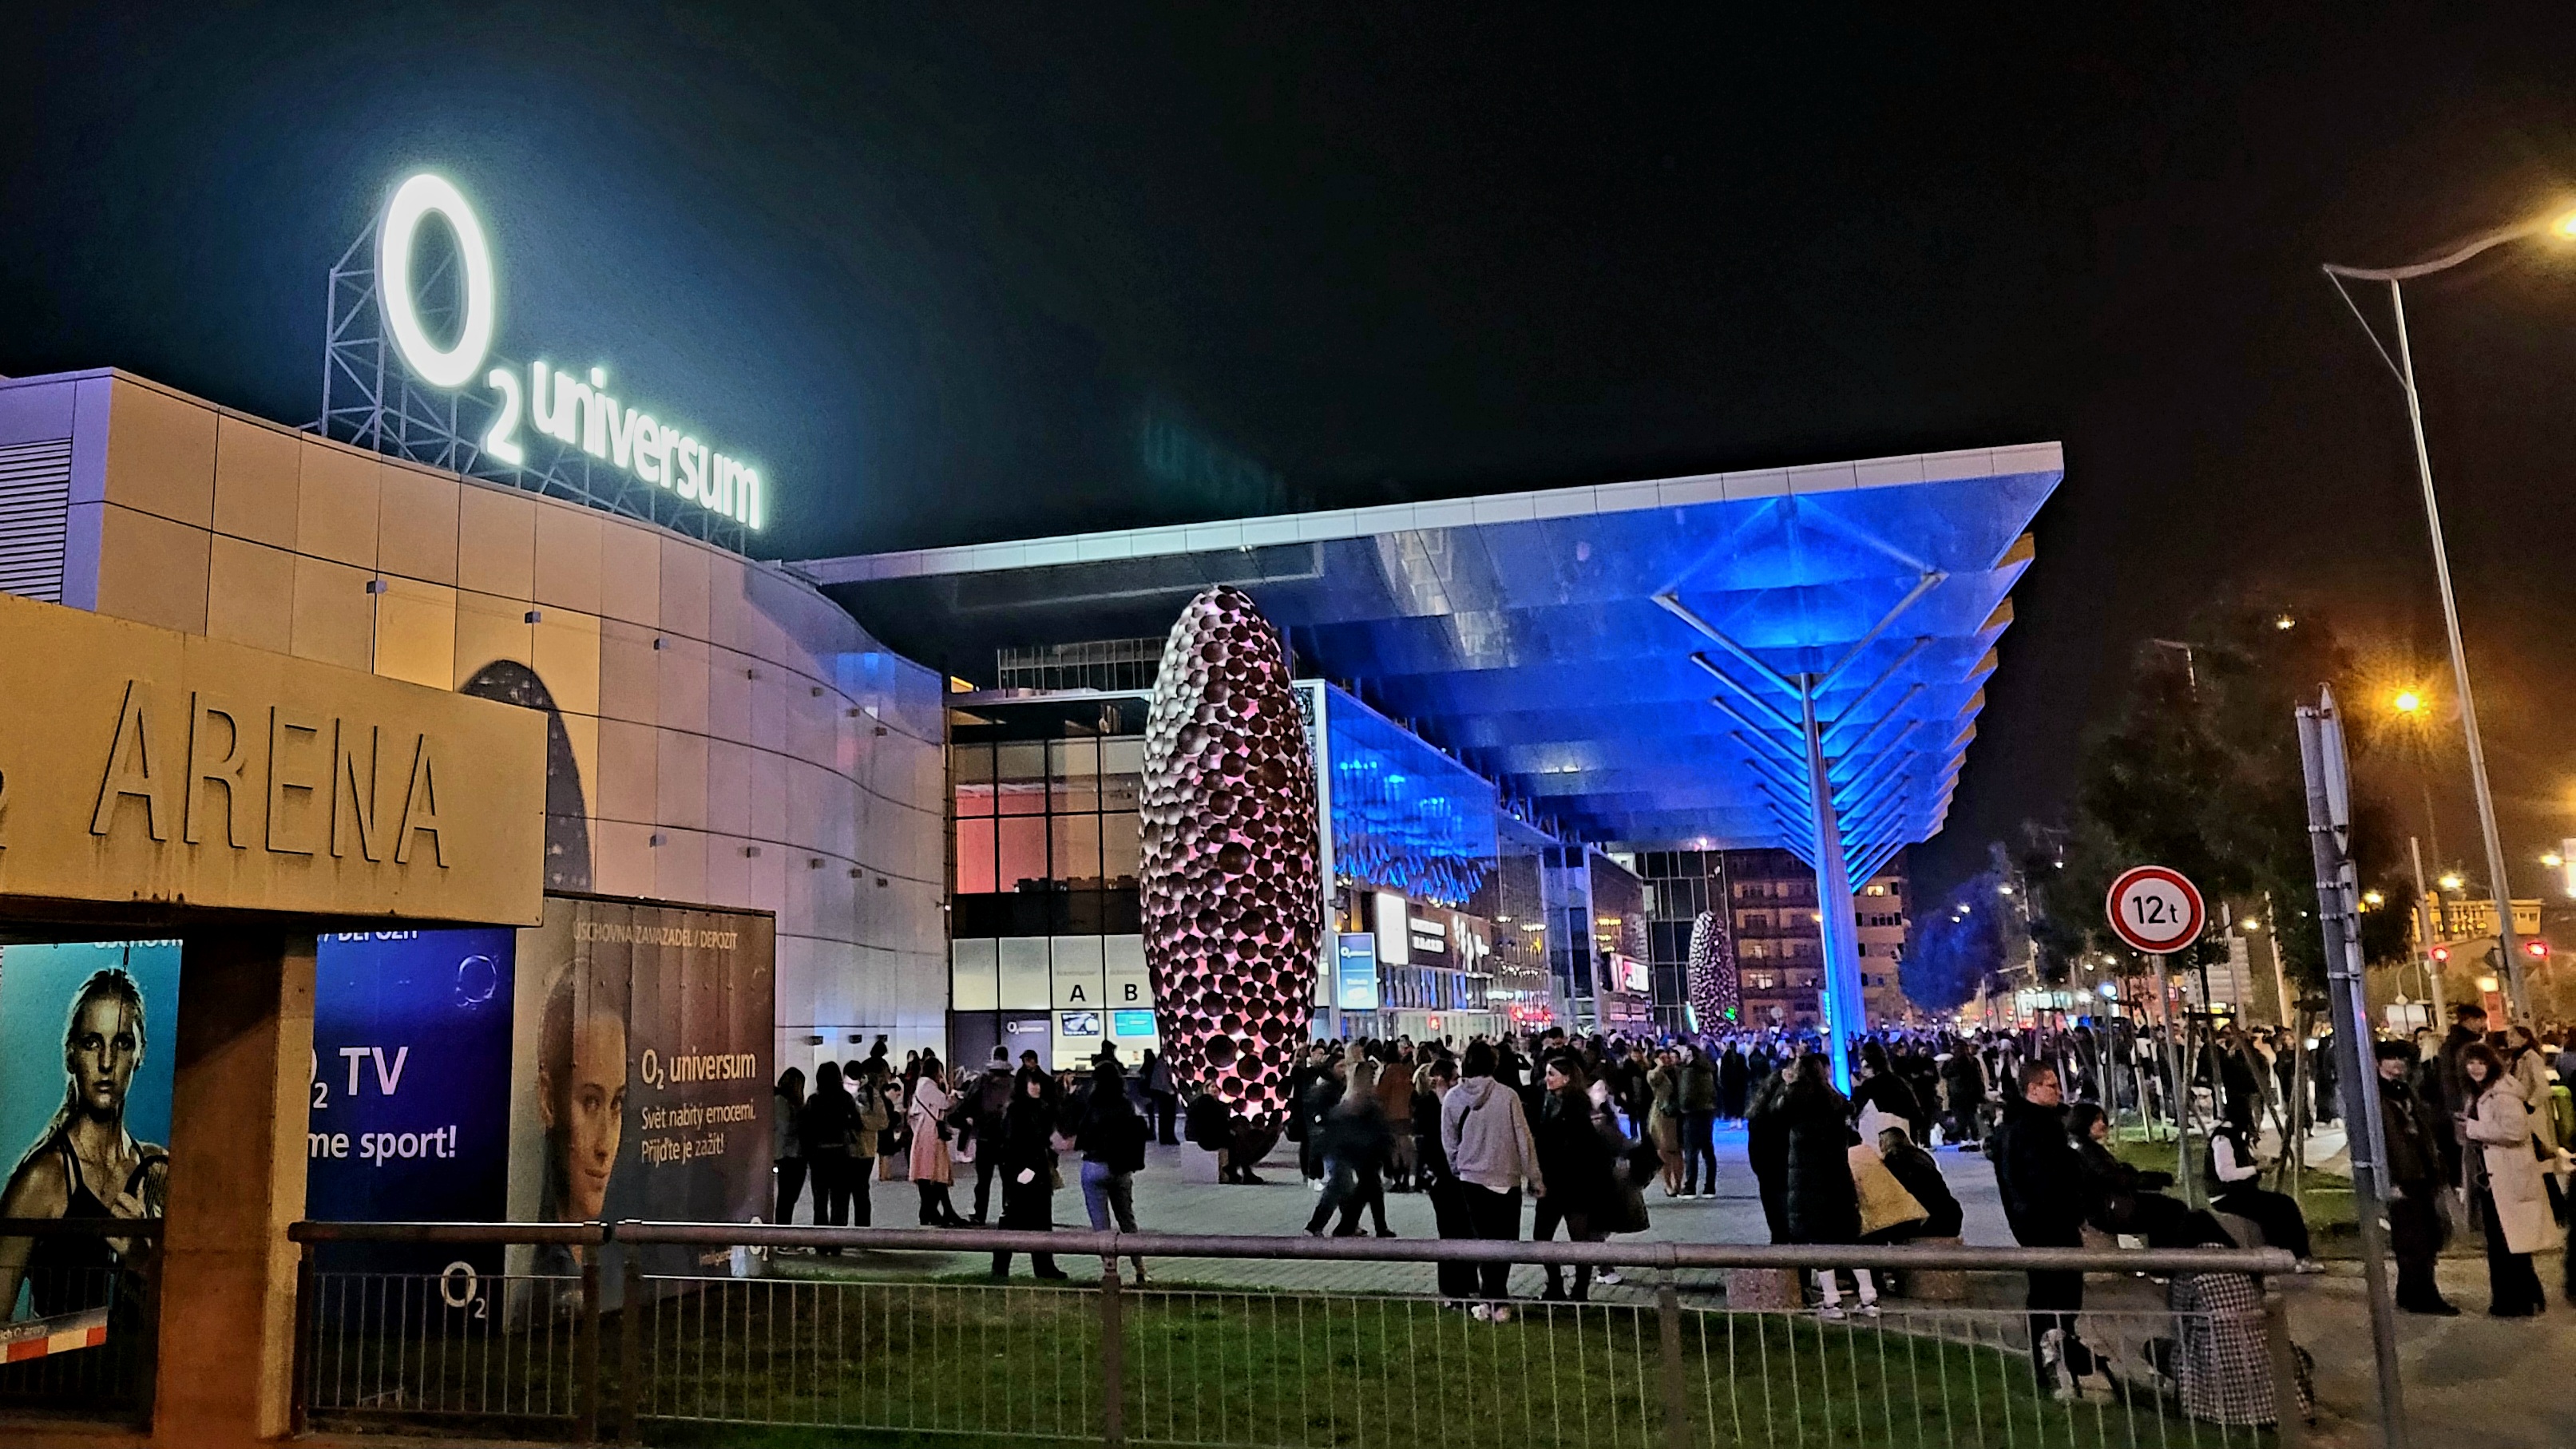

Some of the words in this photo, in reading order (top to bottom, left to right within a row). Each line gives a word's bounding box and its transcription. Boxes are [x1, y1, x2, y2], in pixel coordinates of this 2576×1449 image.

[531, 360, 761, 530] universum
[89, 679, 449, 868] ARENA
[636, 925, 692, 947] ZAVAZADEL
[700, 930, 738, 949] DEPOZIT
[1070, 984, 1086, 1002] A
[1124, 984, 1138, 1001] B
[310, 1048, 328, 1108] 2
[339, 1047, 408, 1095] TV
[642, 1049, 664, 1090] O2
[670, 1046, 756, 1083] universum
[642, 1106, 666, 1130] Svět
[669, 1103, 704, 1130] nabitý
[707, 1098, 756, 1124] emocemi.
[360, 1125, 456, 1167] sport!
[641, 1137, 680, 1168] Přijďte
[682, 1135, 693, 1165] je
[440, 1261, 485, 1319] O2
